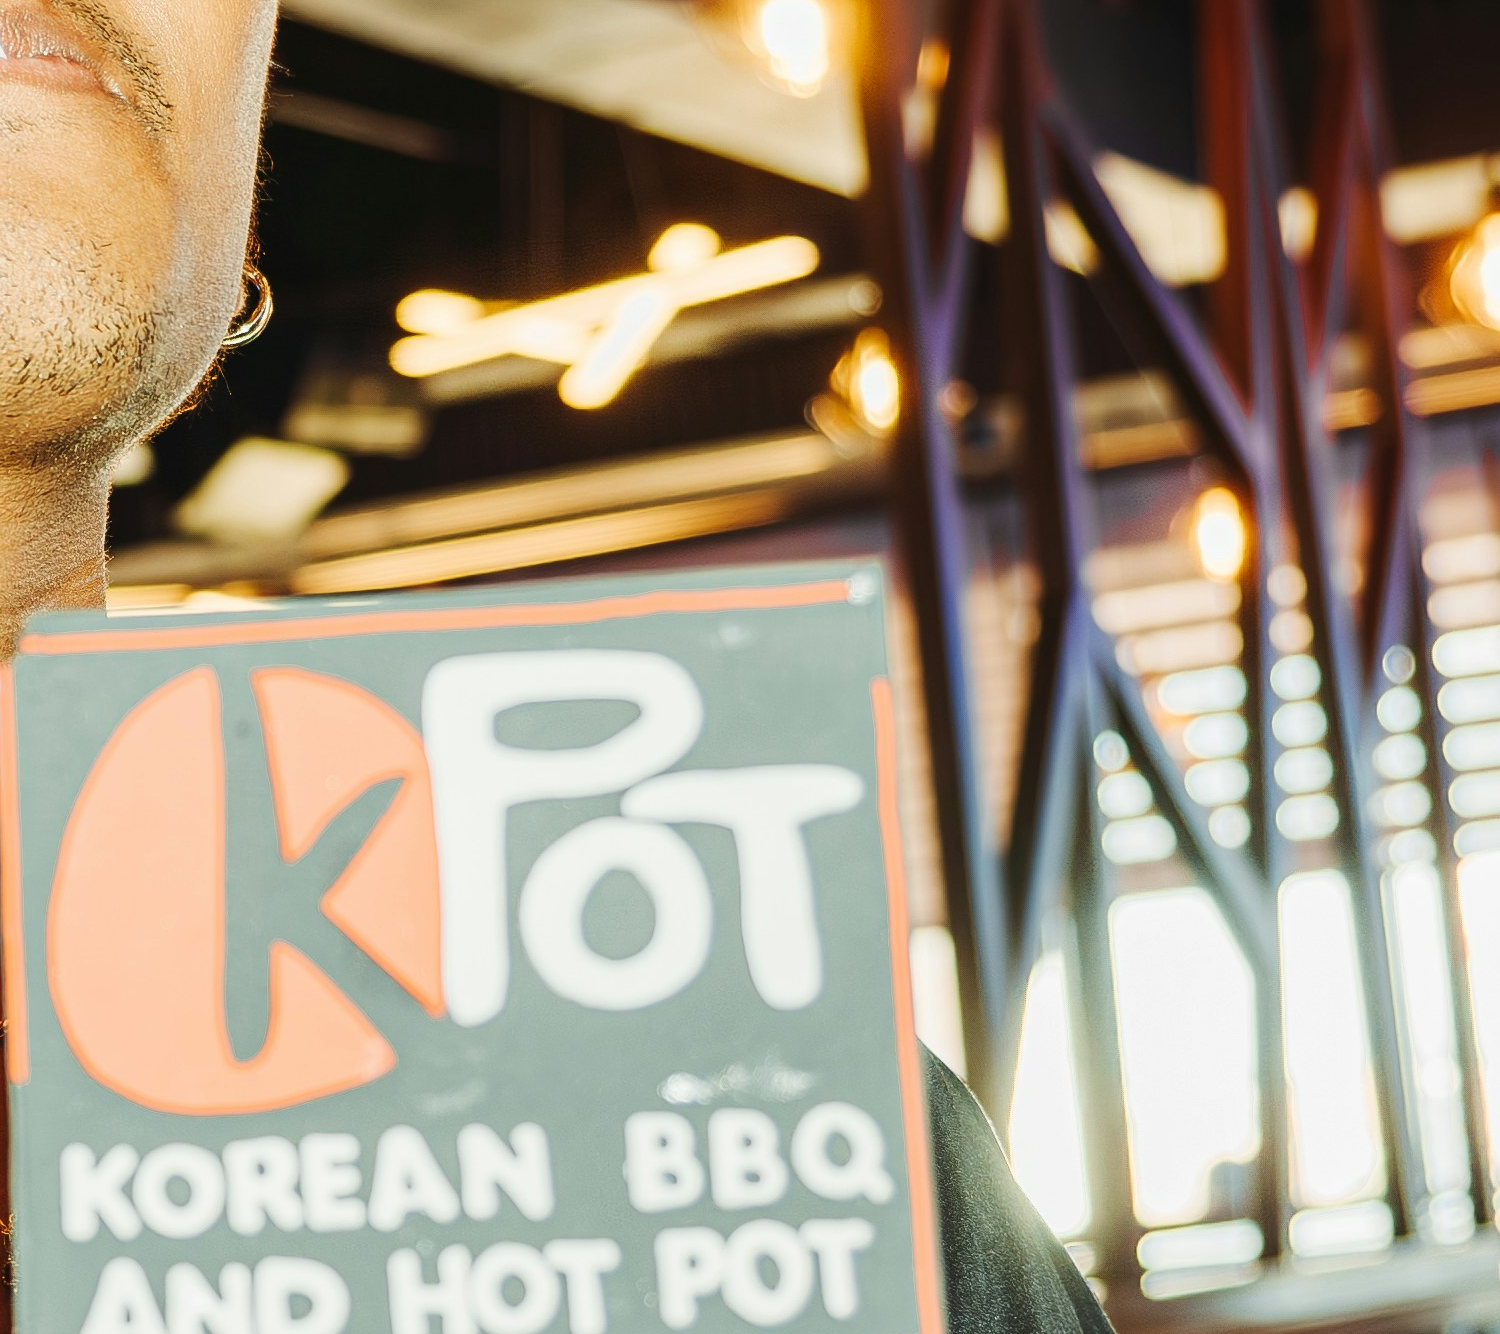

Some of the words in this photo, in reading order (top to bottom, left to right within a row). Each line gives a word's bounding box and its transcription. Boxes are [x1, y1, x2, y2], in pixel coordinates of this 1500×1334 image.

[60, 1122, 554, 1242] KOREAN
[624, 1102, 895, 1214] BBQ
[654, 1219, 875, 1330] POT
